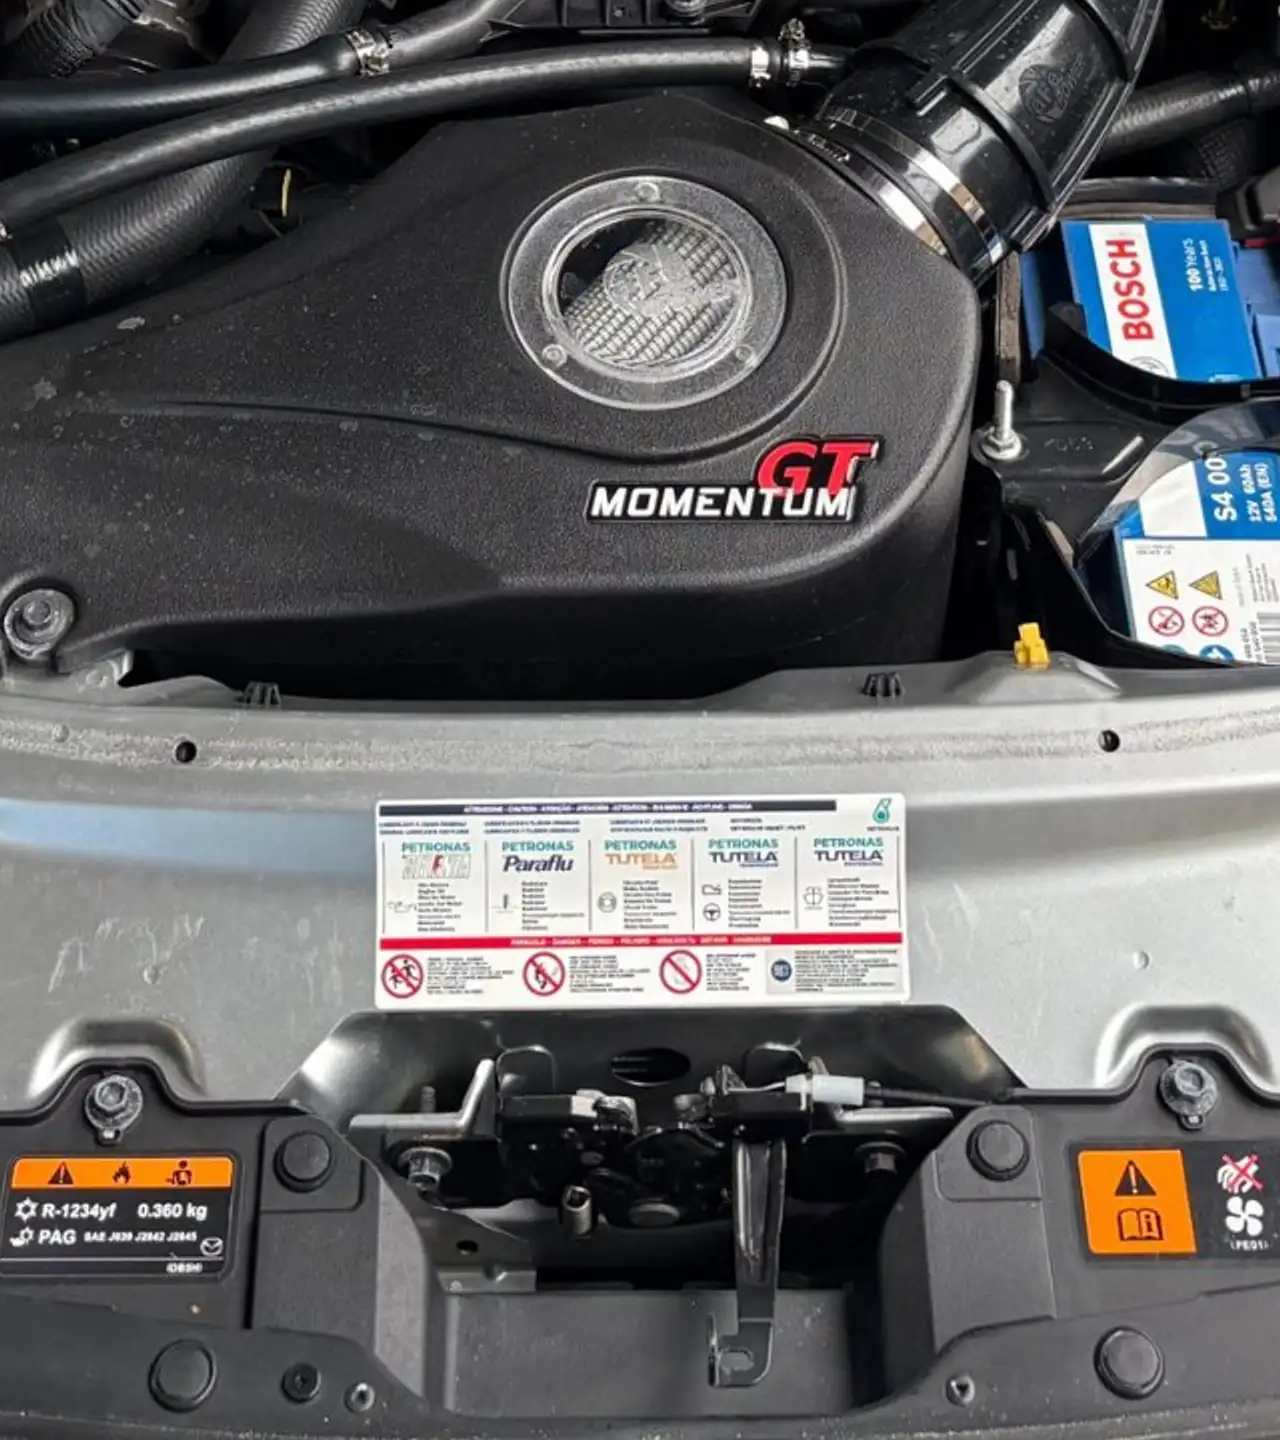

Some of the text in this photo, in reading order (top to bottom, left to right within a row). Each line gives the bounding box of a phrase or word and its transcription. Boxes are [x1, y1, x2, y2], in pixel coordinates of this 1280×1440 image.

[1182, 238, 1203, 292] 100 Years
[1105, 239, 1154, 341] BOSCH
[757, 440, 878, 496] GT
[591, 486, 855, 520] MOMENTUM
[1208, 490, 1238, 522] S4
[402, 842, 471, 853] PETRONAS
[502, 841, 574, 852] PETRONAS
[605, 840, 677, 851] PETRONAS
[708, 838, 779, 849] PETRONAS
[813, 837, 884, 848] PETRONAS
[605, 853, 677, 865] TUTELA
[709, 851, 778, 863] TUTELA
[814, 850, 883, 861] TUTELA
[503, 855, 574, 872] Paraflu
[41, 1202, 208, 1221] R-1234yf 0.360 kg
[38, 1229, 77, 1245] PAG
